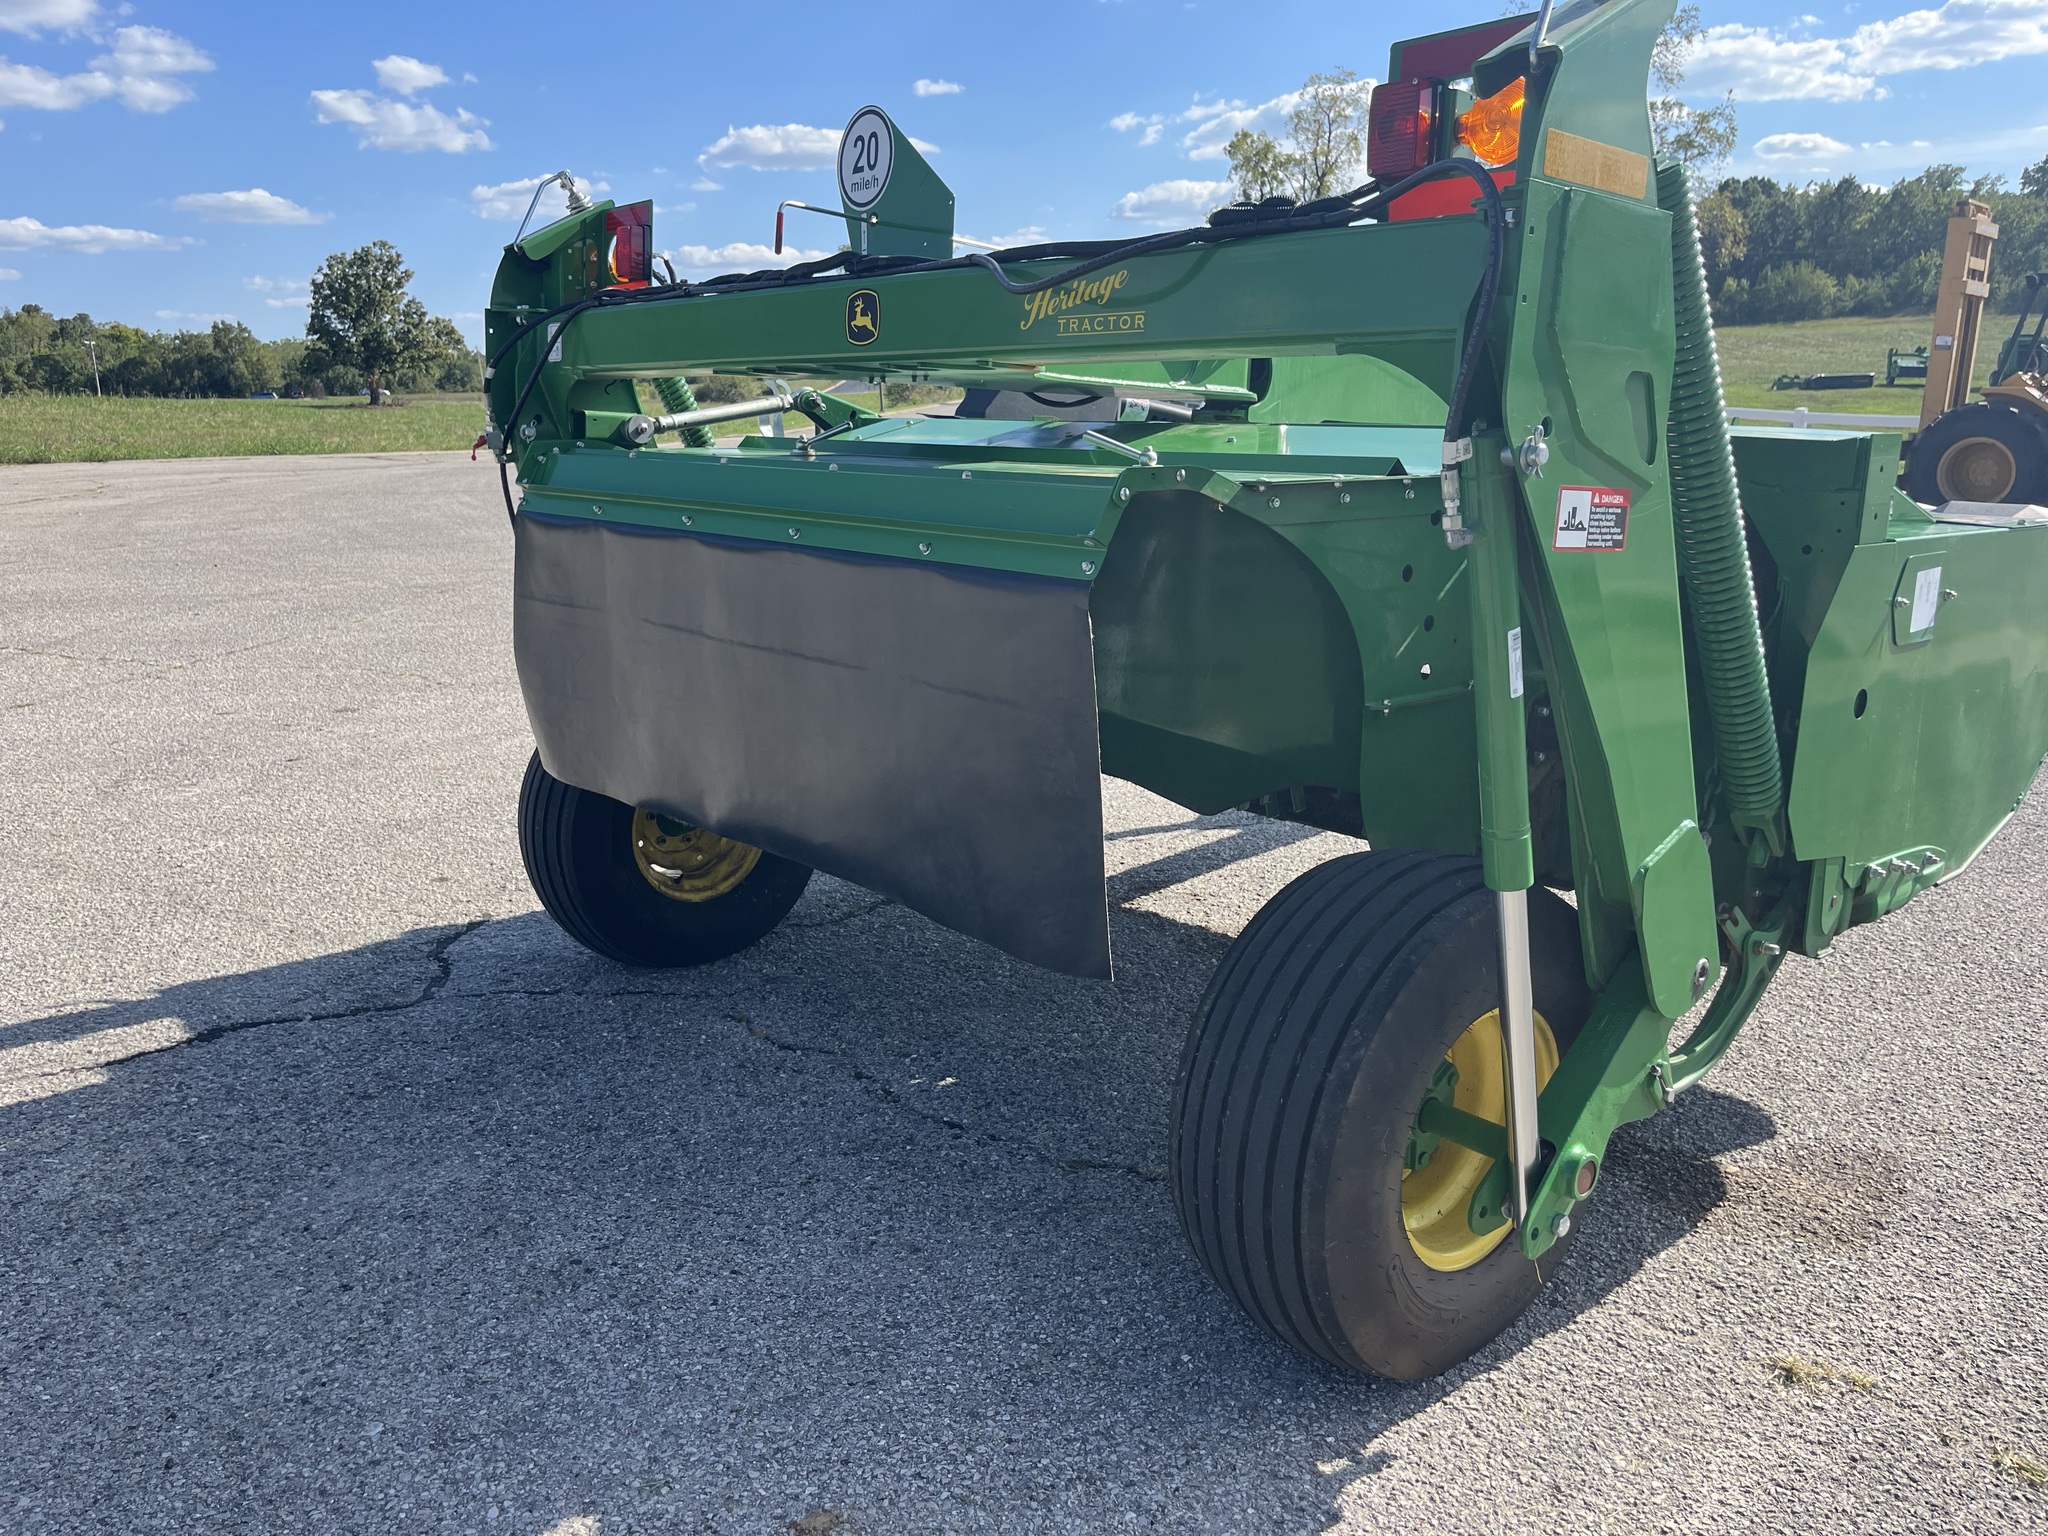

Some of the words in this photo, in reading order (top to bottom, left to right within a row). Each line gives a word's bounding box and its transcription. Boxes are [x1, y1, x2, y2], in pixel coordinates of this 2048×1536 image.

[852, 131, 879, 175] 20
[850, 174, 879, 193] mile/h
[1020, 269, 1130, 331] Heritage
[1058, 314, 1145, 333] TRACTOR
[1601, 494, 1624, 504] DANGER
[1591, 513, 1605, 521] crushing
[1587, 540, 1605, 548] harvesting
